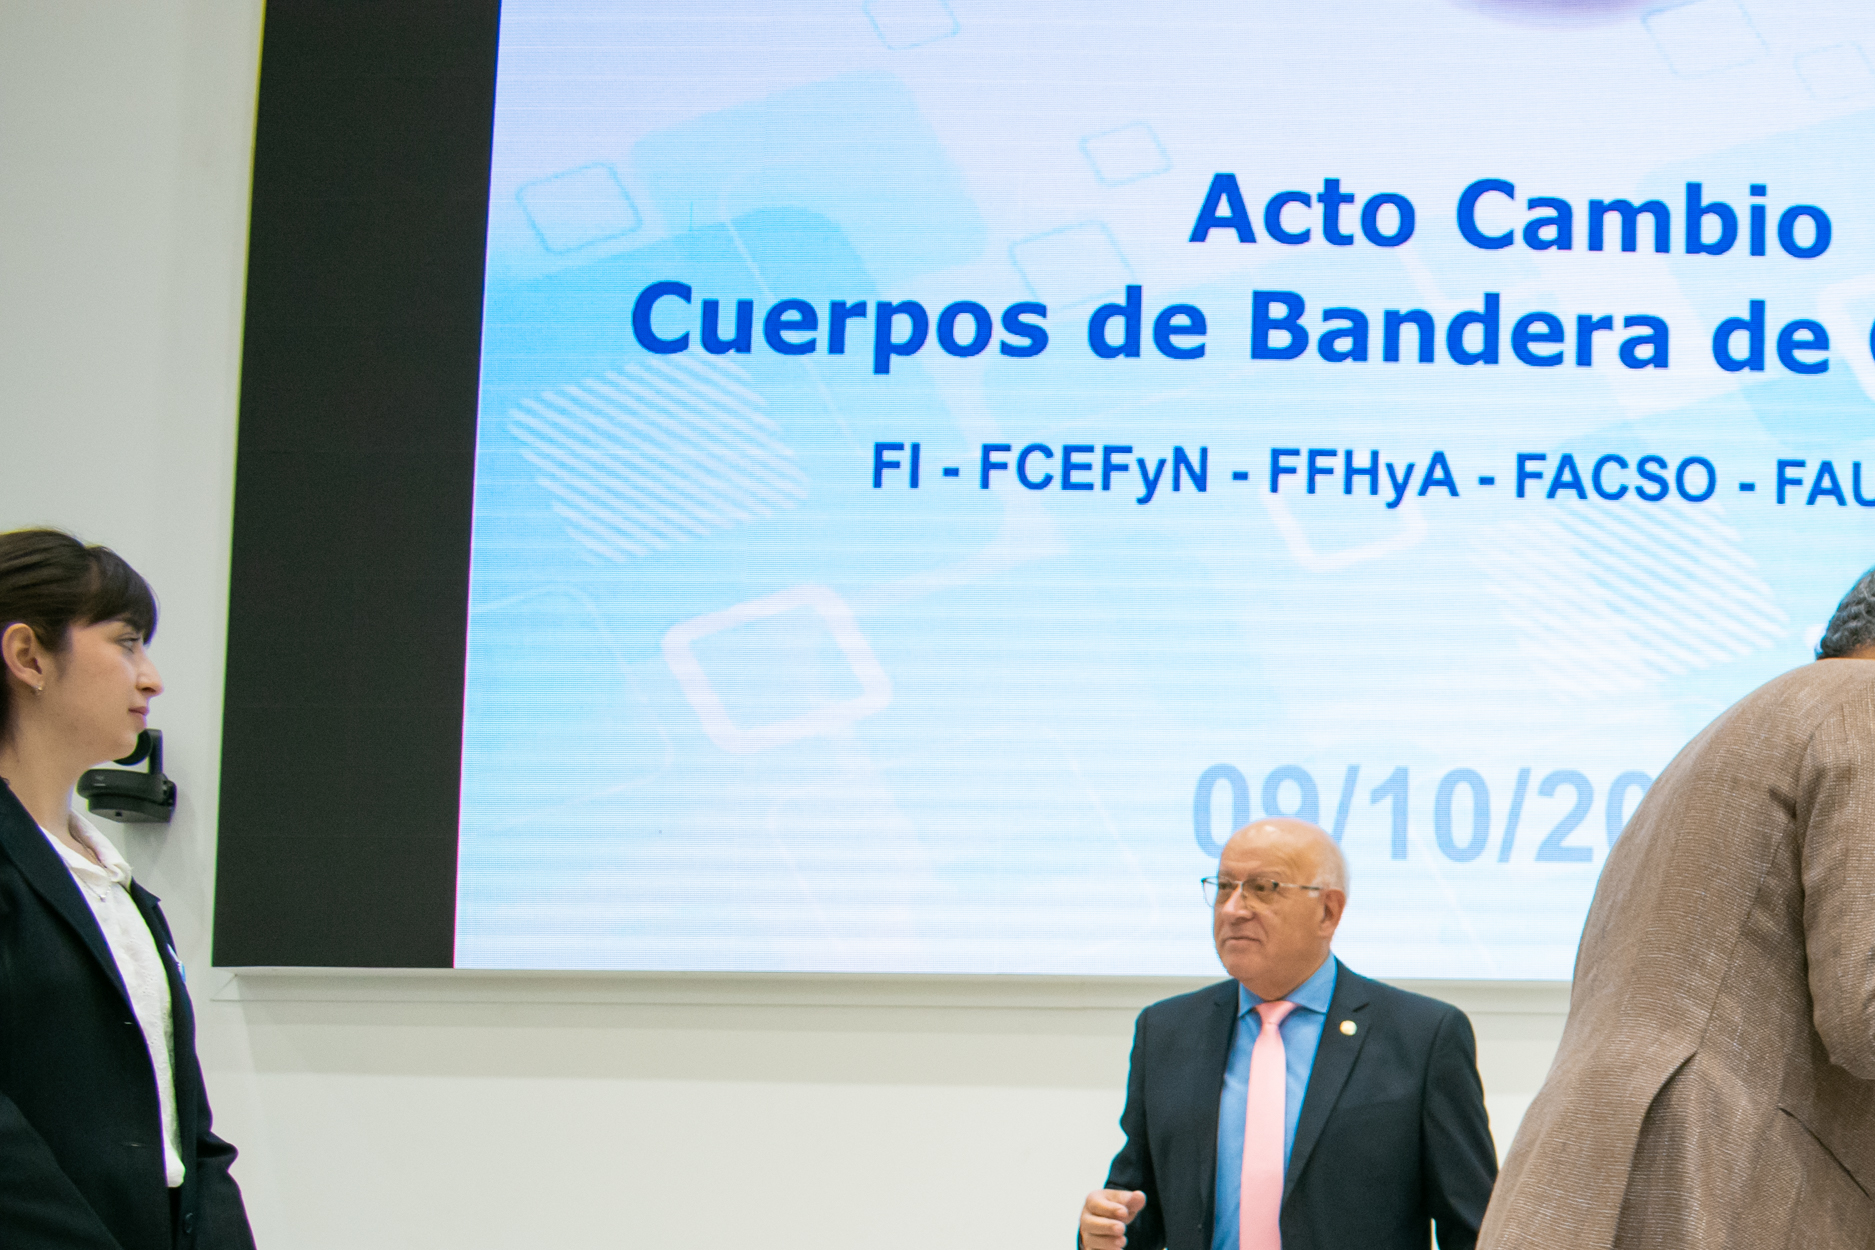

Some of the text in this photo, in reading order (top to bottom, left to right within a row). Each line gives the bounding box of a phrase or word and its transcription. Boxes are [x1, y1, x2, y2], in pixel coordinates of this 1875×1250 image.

[1189, 173, 1833, 260] Acto Cambio
[631, 281, 1050, 375] Cuerpos
[1087, 285, 1208, 361] de
[1250, 291, 1670, 371] Bandera
[1711, 300, 1830, 376] de
[872, 441, 921, 490] FI
[980, 443, 1209, 505] FCEFyN
[1270, 447, 1460, 510] FFHyA
[1516, 452, 1717, 504] FACSO
